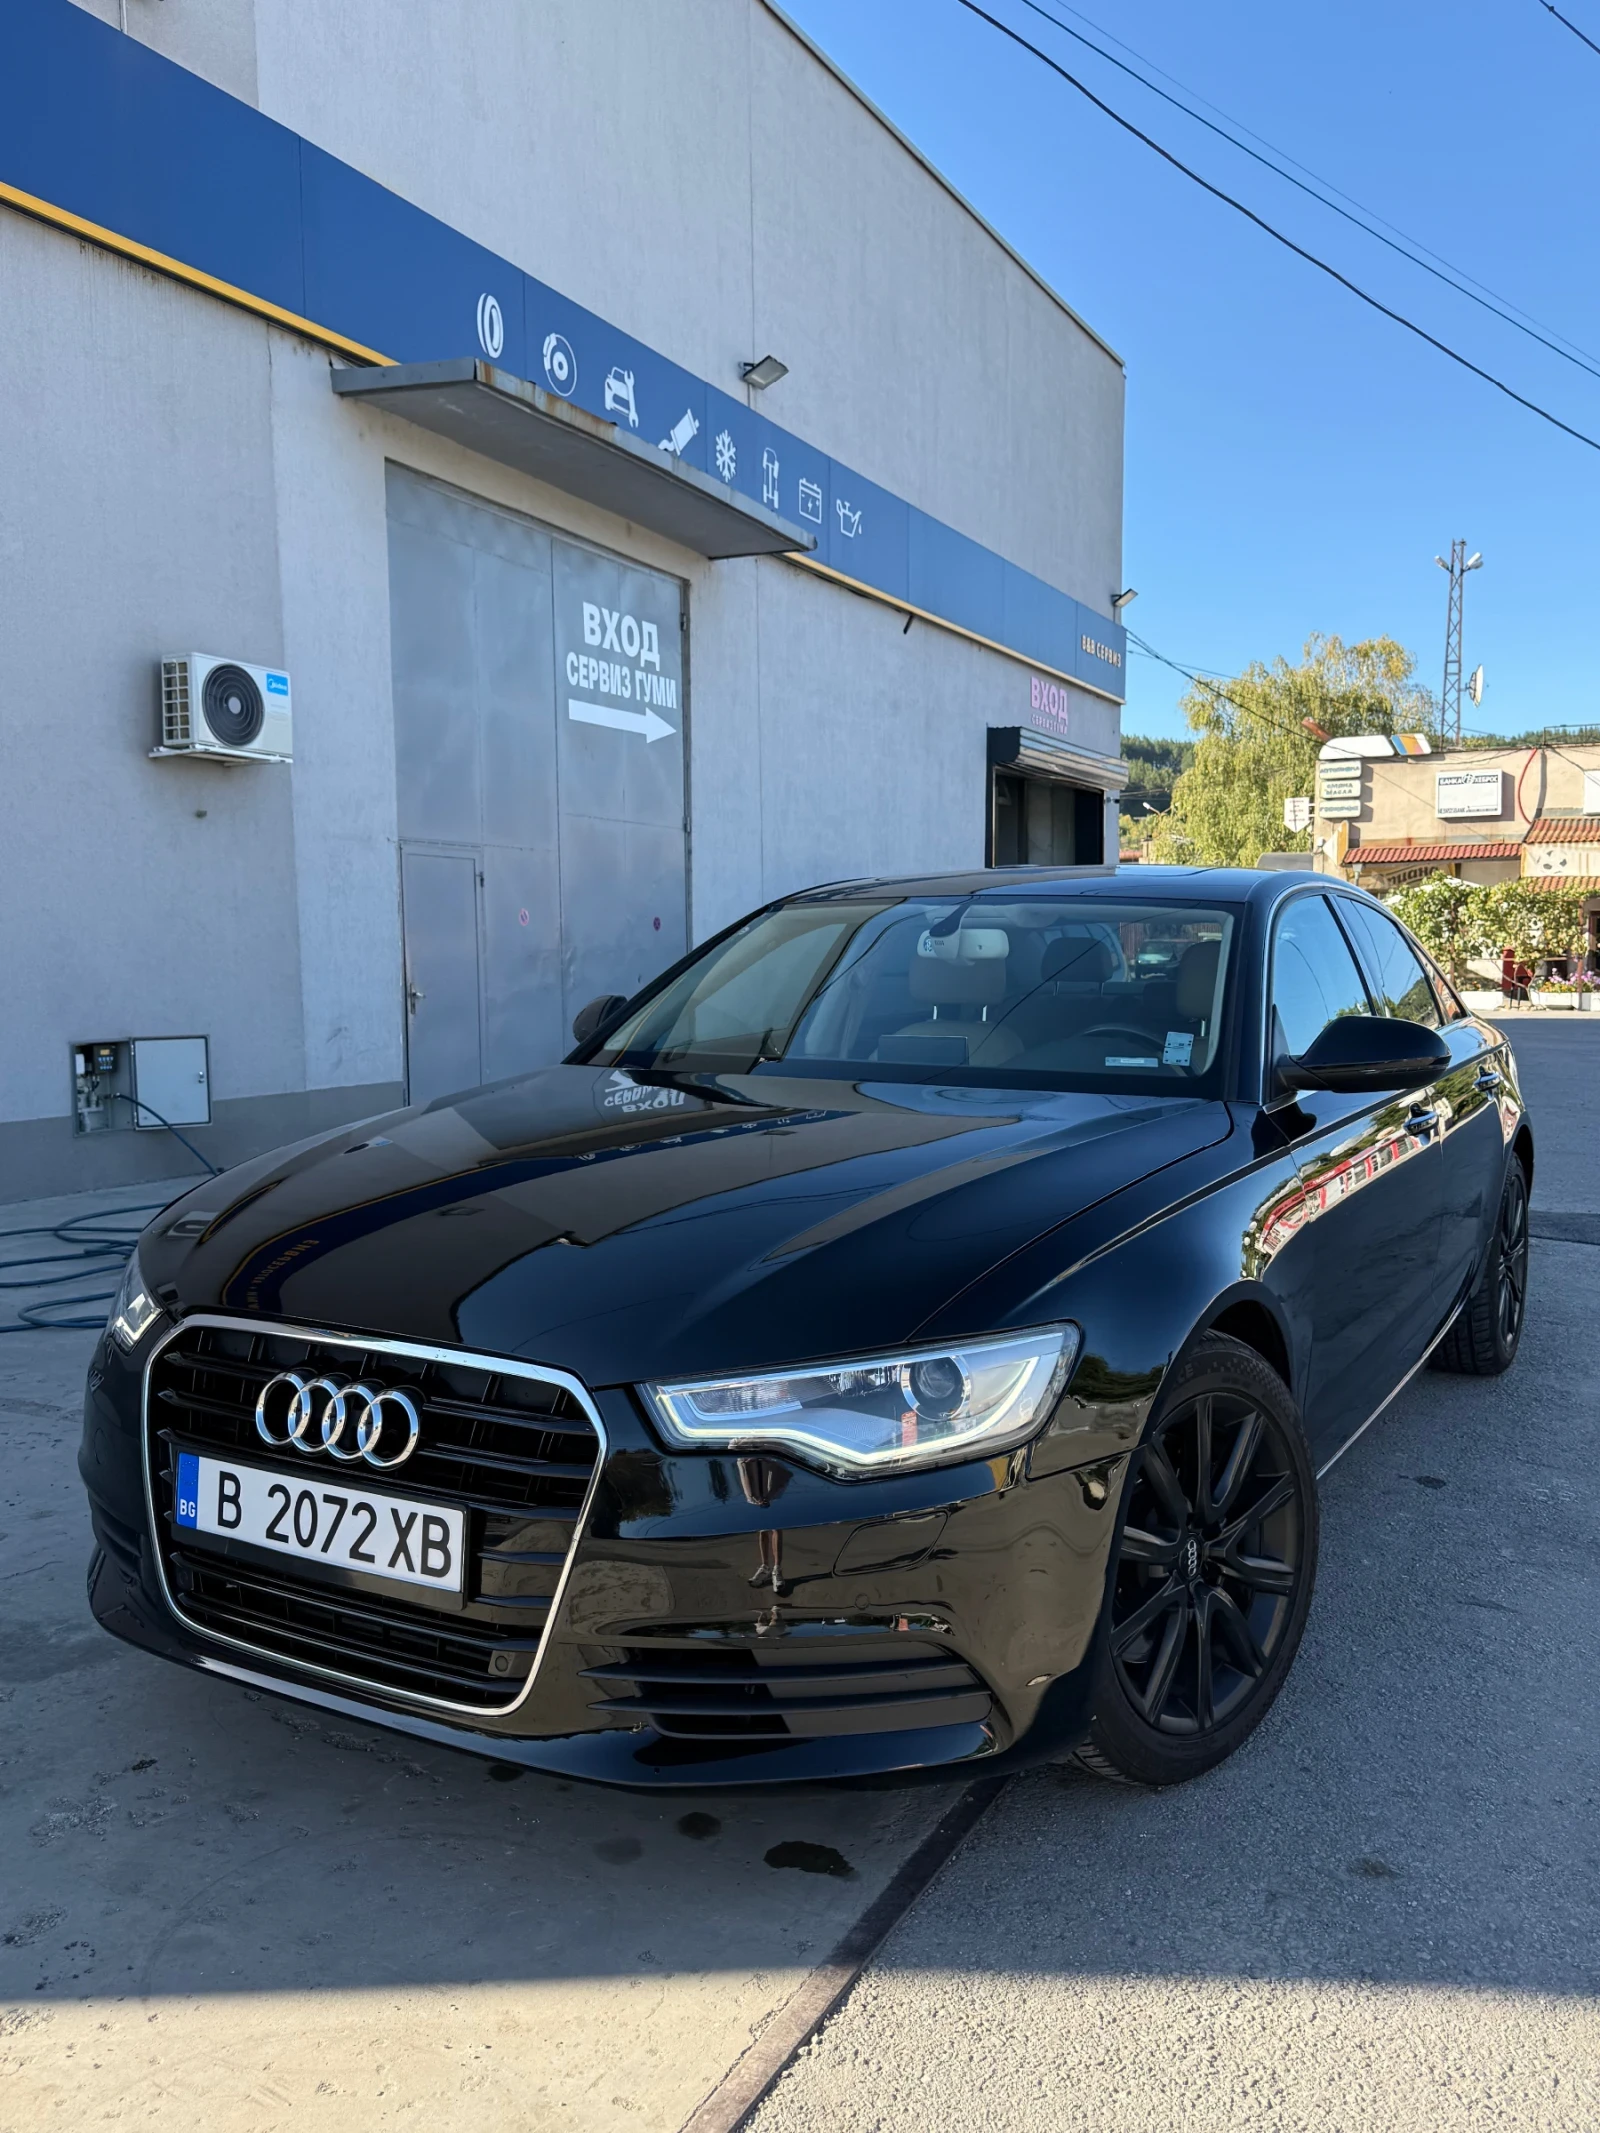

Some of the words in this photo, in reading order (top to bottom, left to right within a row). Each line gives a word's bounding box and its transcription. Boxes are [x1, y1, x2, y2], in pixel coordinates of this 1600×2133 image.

[583, 601, 660, 671] ВХОД
[1096, 642, 1121, 668] СЕРВИЗ
[566, 651, 632, 699] СЕРВИЗ
[635, 669, 677, 709] ГУМИ
[1031, 676, 1068, 726] ВХОД
[179, 1498, 196, 1518] BG
[217, 1470, 241, 1529] B
[265, 1483, 377, 1564] 2072
[387, 1507, 452, 1578] XB
